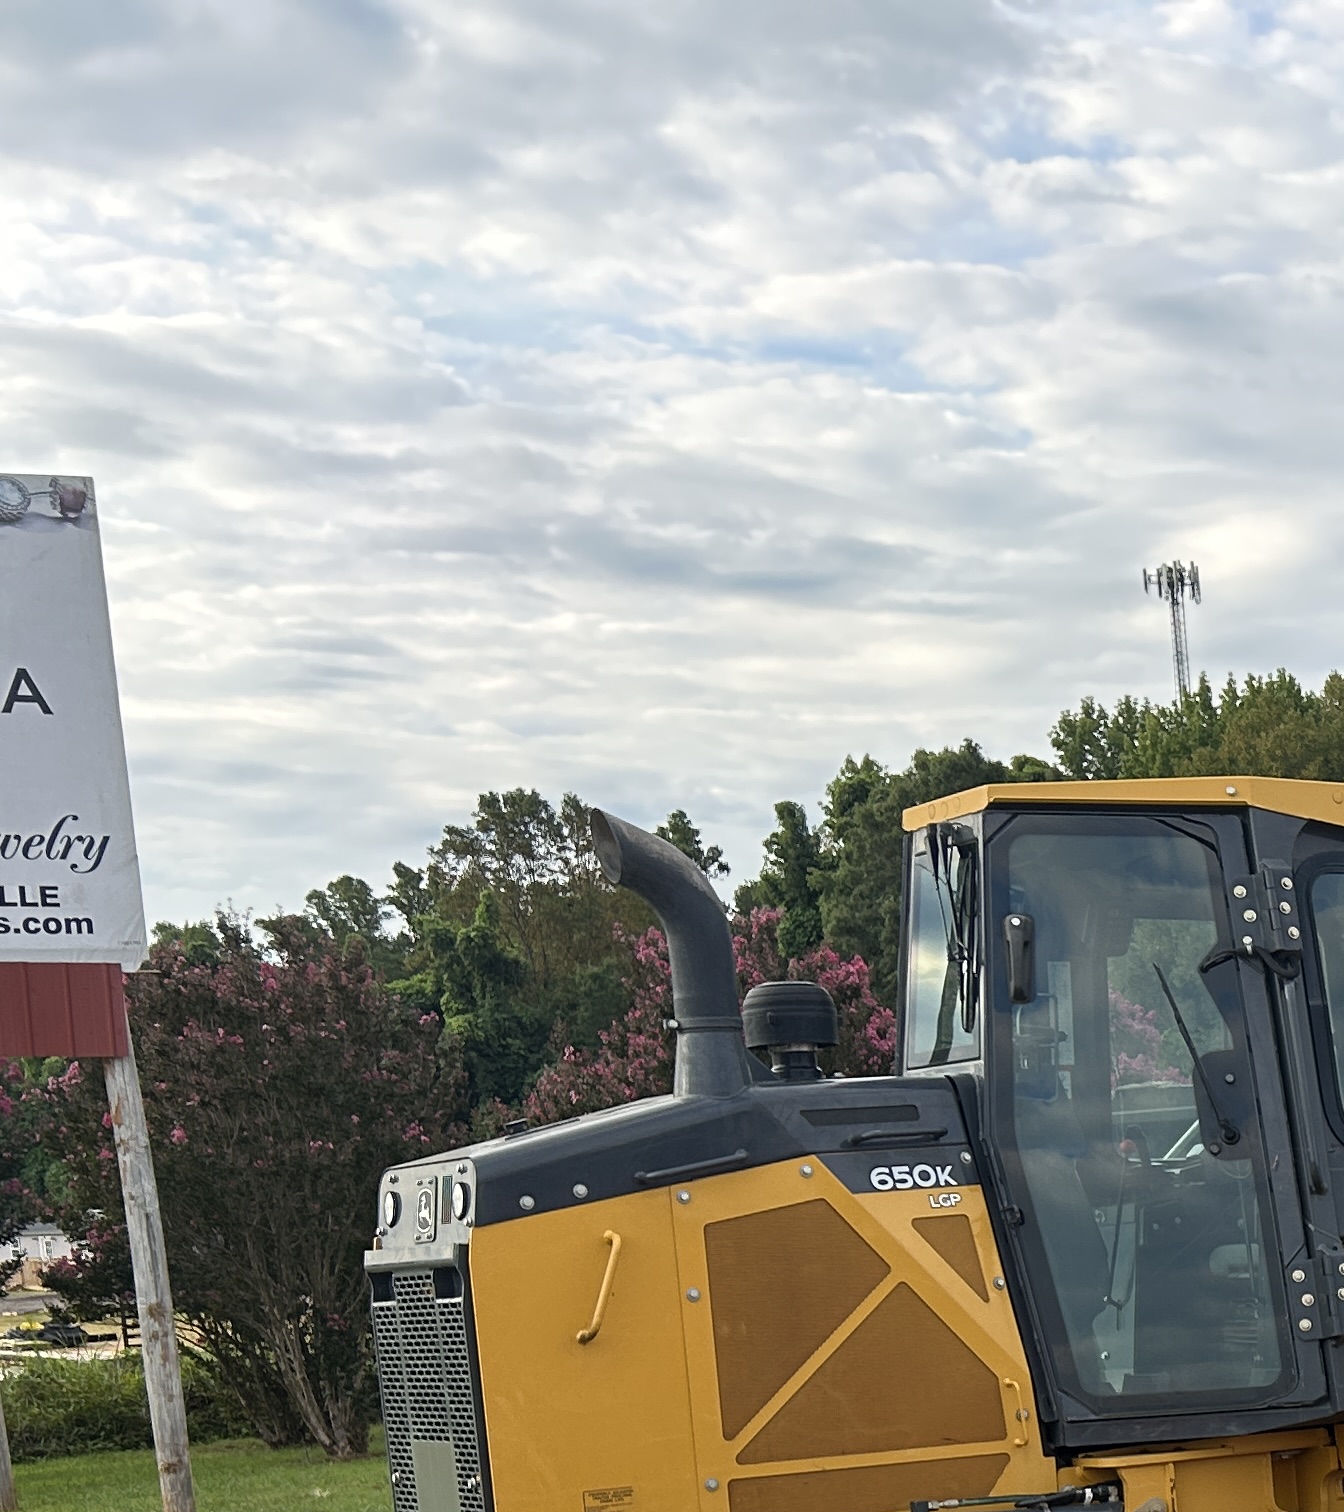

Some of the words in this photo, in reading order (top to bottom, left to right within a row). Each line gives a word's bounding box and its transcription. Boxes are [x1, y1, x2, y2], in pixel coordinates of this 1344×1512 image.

[1, 667, 54, 716] A
[0, 885, 61, 908] LLE
[870, 1164, 958, 1191] 650K
[928, 1193, 962, 1208] LGP
